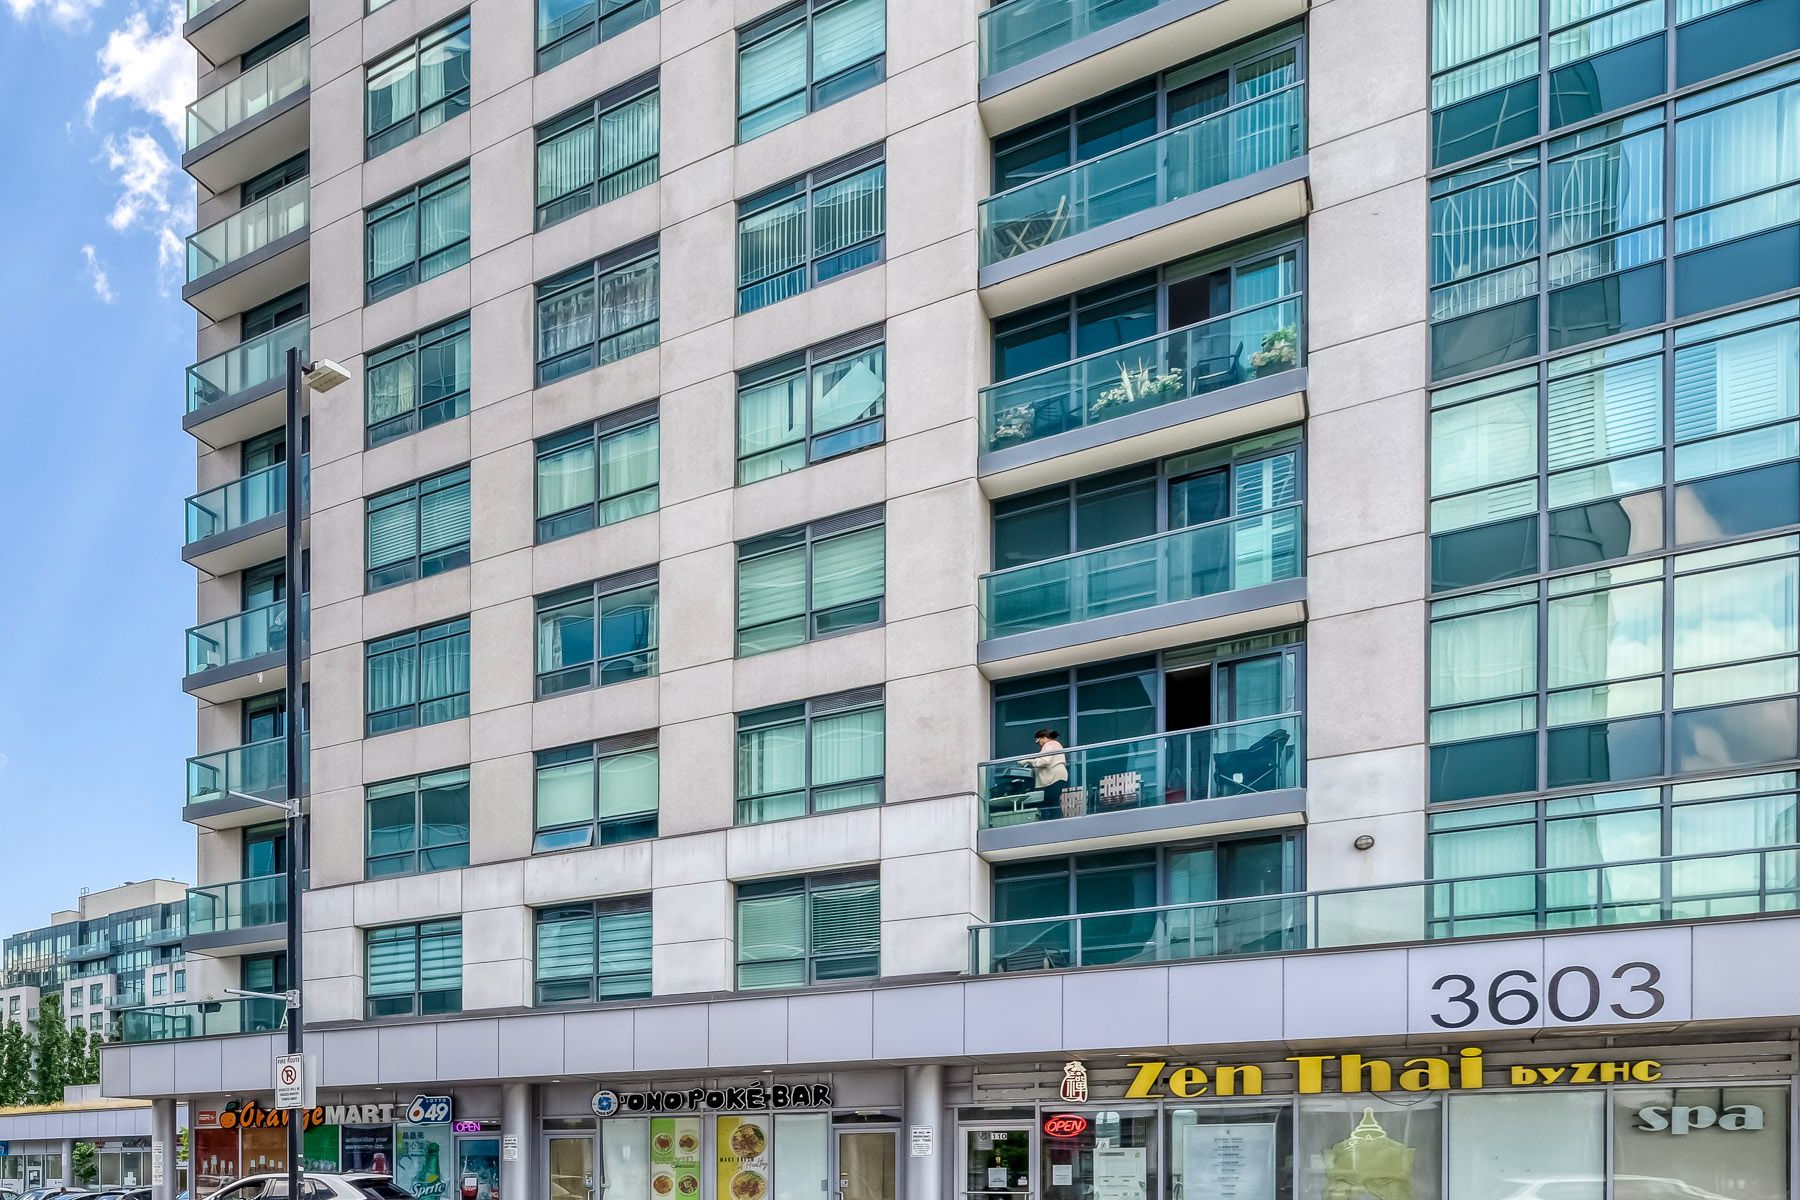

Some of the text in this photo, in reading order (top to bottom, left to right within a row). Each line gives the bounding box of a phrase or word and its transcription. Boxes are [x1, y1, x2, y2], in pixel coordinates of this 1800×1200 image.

[1430, 961, 1665, 1028] 3603
[1123, 1047, 1663, 1099] Zen Thai by ZHC
[771, 1084, 832, 1109] BAR
[324, 1103, 394, 1125] MART
[1638, 1104, 1764, 1135] spa
[456, 1122, 481, 1132] OPEN
[1047, 1120, 1082, 1132] OPEN
[412, 1182, 447, 1199] Sprite
